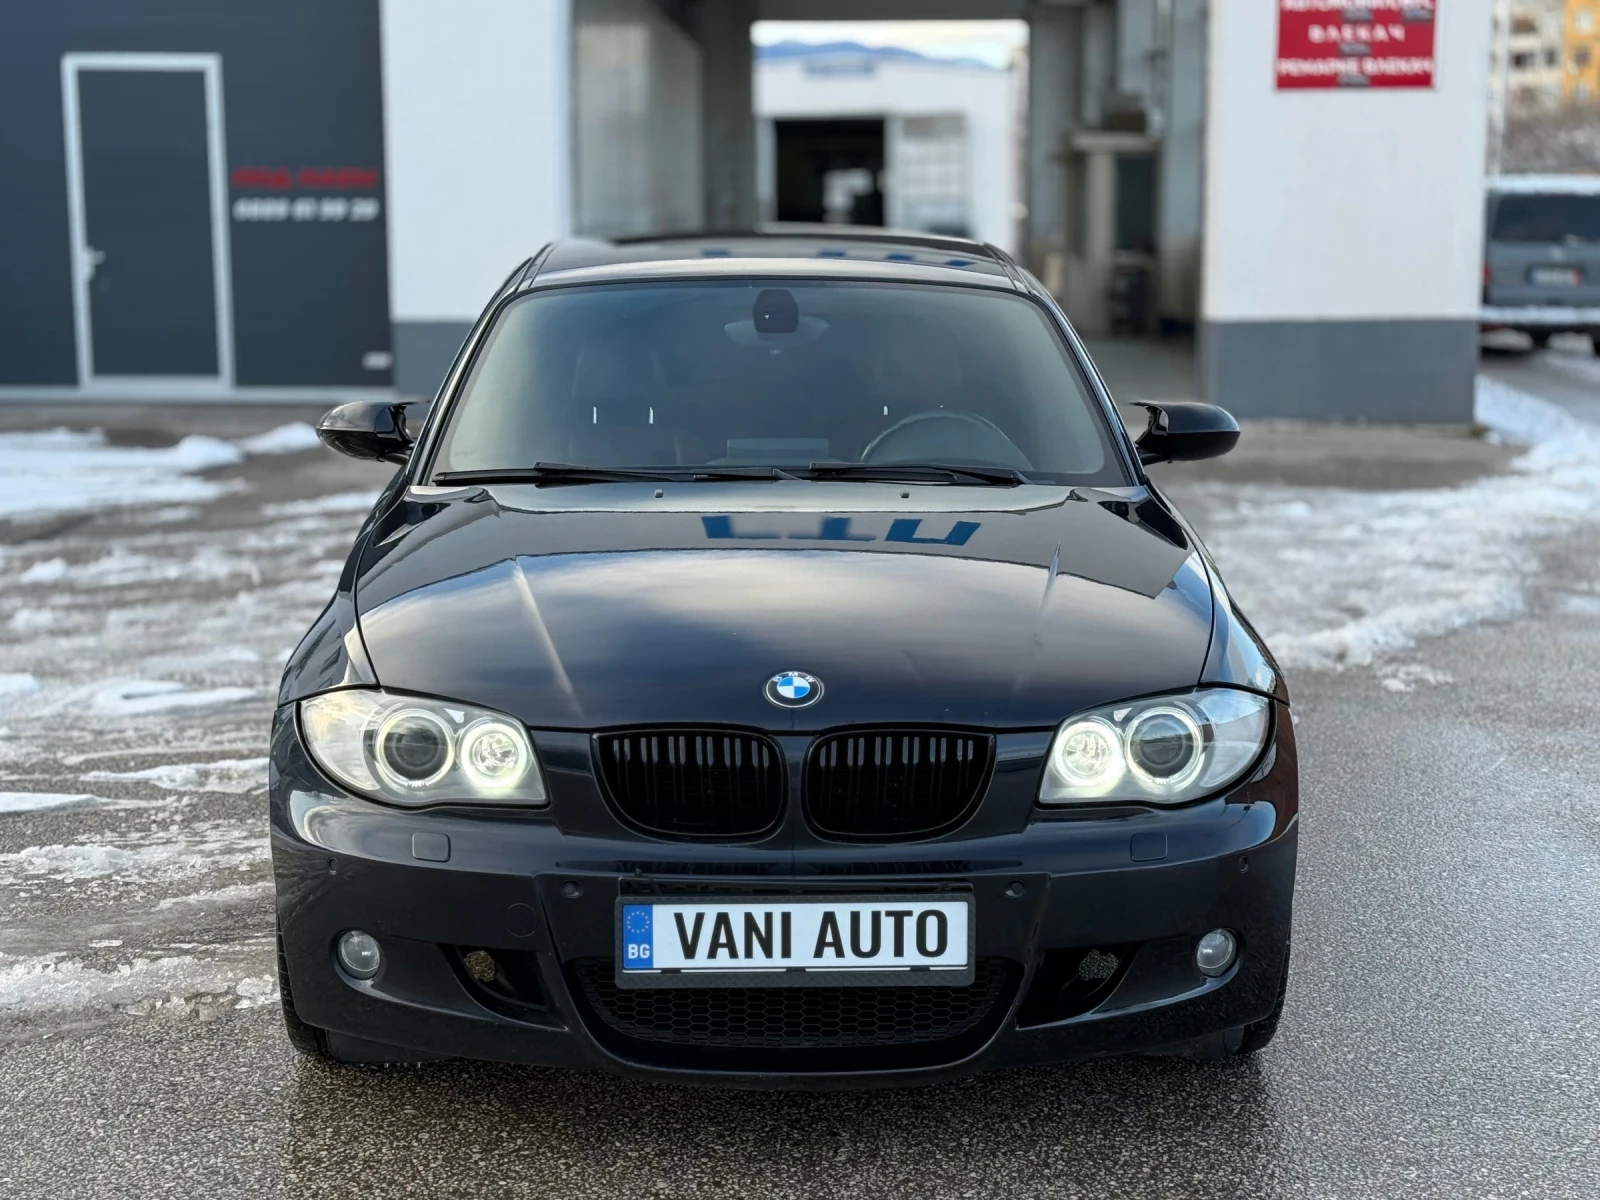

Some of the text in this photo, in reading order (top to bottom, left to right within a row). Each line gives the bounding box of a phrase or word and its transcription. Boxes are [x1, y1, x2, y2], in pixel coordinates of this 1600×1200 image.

[627, 943, 650, 959] BG
[673, 909, 949, 960] VANI AUTO
